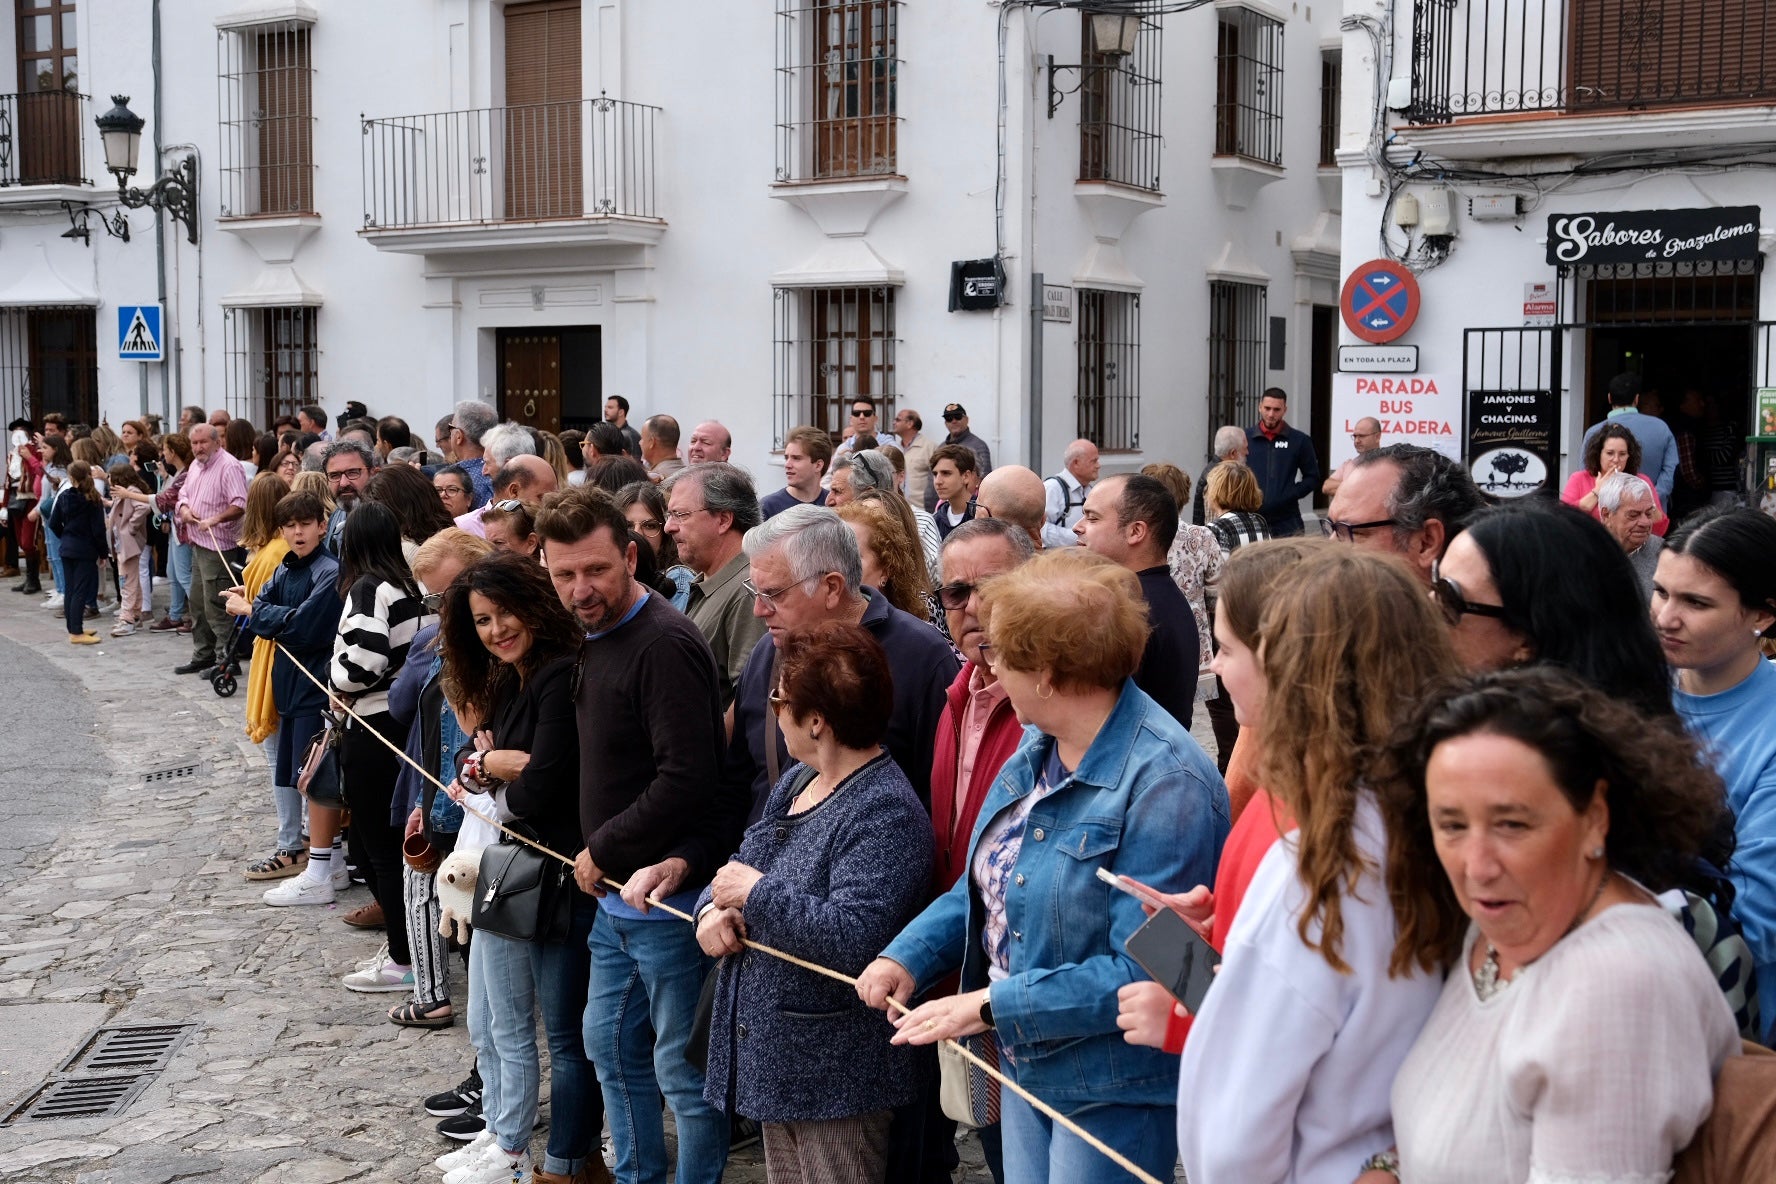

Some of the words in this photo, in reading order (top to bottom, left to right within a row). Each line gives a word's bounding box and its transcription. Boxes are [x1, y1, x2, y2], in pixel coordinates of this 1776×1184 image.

[1555, 216, 1664, 262] Sabores
[1645, 249, 1657, 258] de
[1663, 222, 1756, 258] Grazalema
[1525, 303, 1553, 311] Alarma
[1356, 378, 1439, 395] PARADA
[1483, 395, 1536, 404] JAMONES
[1379, 400, 1413, 414] BUS
[1480, 414, 1538, 424] CHACINAS
[1345, 419, 1452, 435] LZADERA
[1471, 427, 1507, 439] Jamones
[1508, 426, 1549, 440] Guillermo
